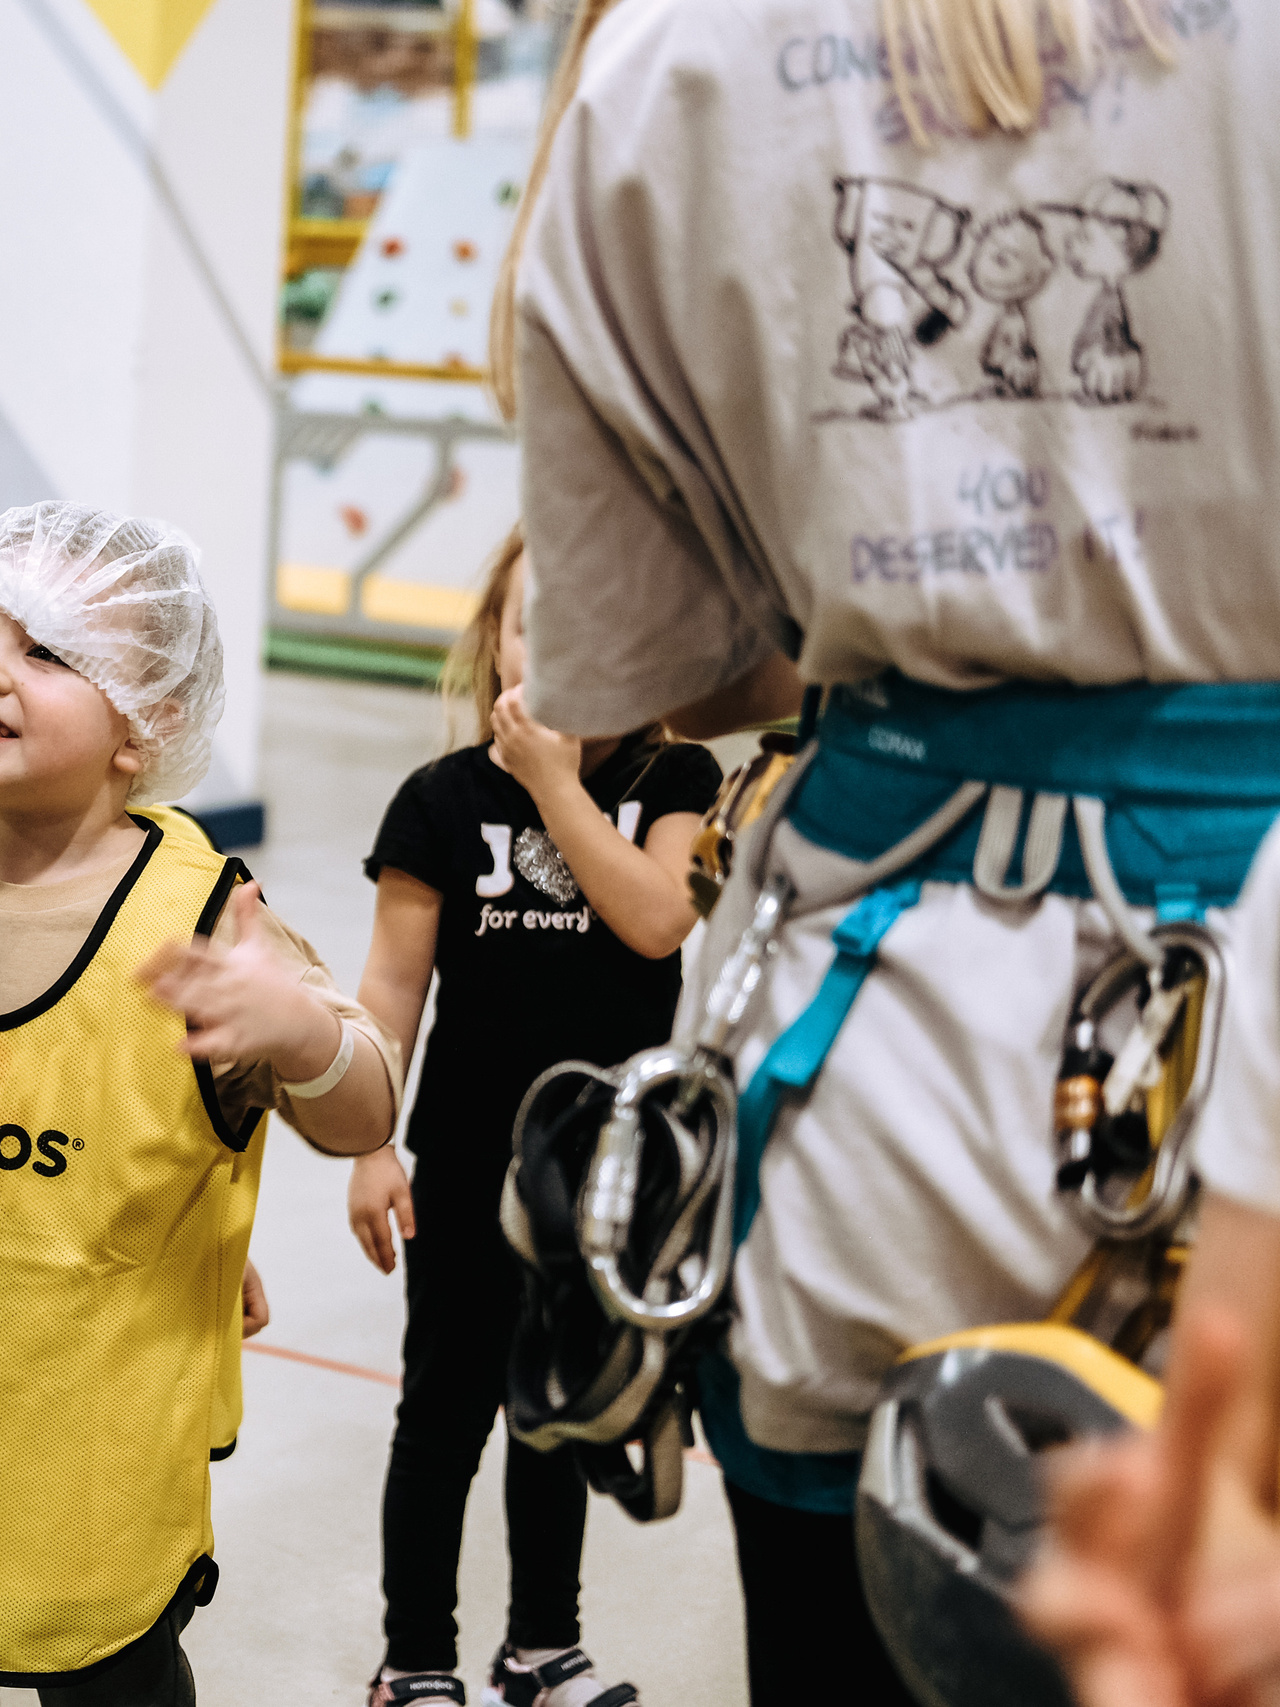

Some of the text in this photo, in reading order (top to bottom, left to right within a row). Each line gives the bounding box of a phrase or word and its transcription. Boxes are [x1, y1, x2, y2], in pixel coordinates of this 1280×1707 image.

[958, 465, 1049, 515] YOU
[851, 523, 1058, 583] DESERVED
[475, 903, 597, 936] for every
